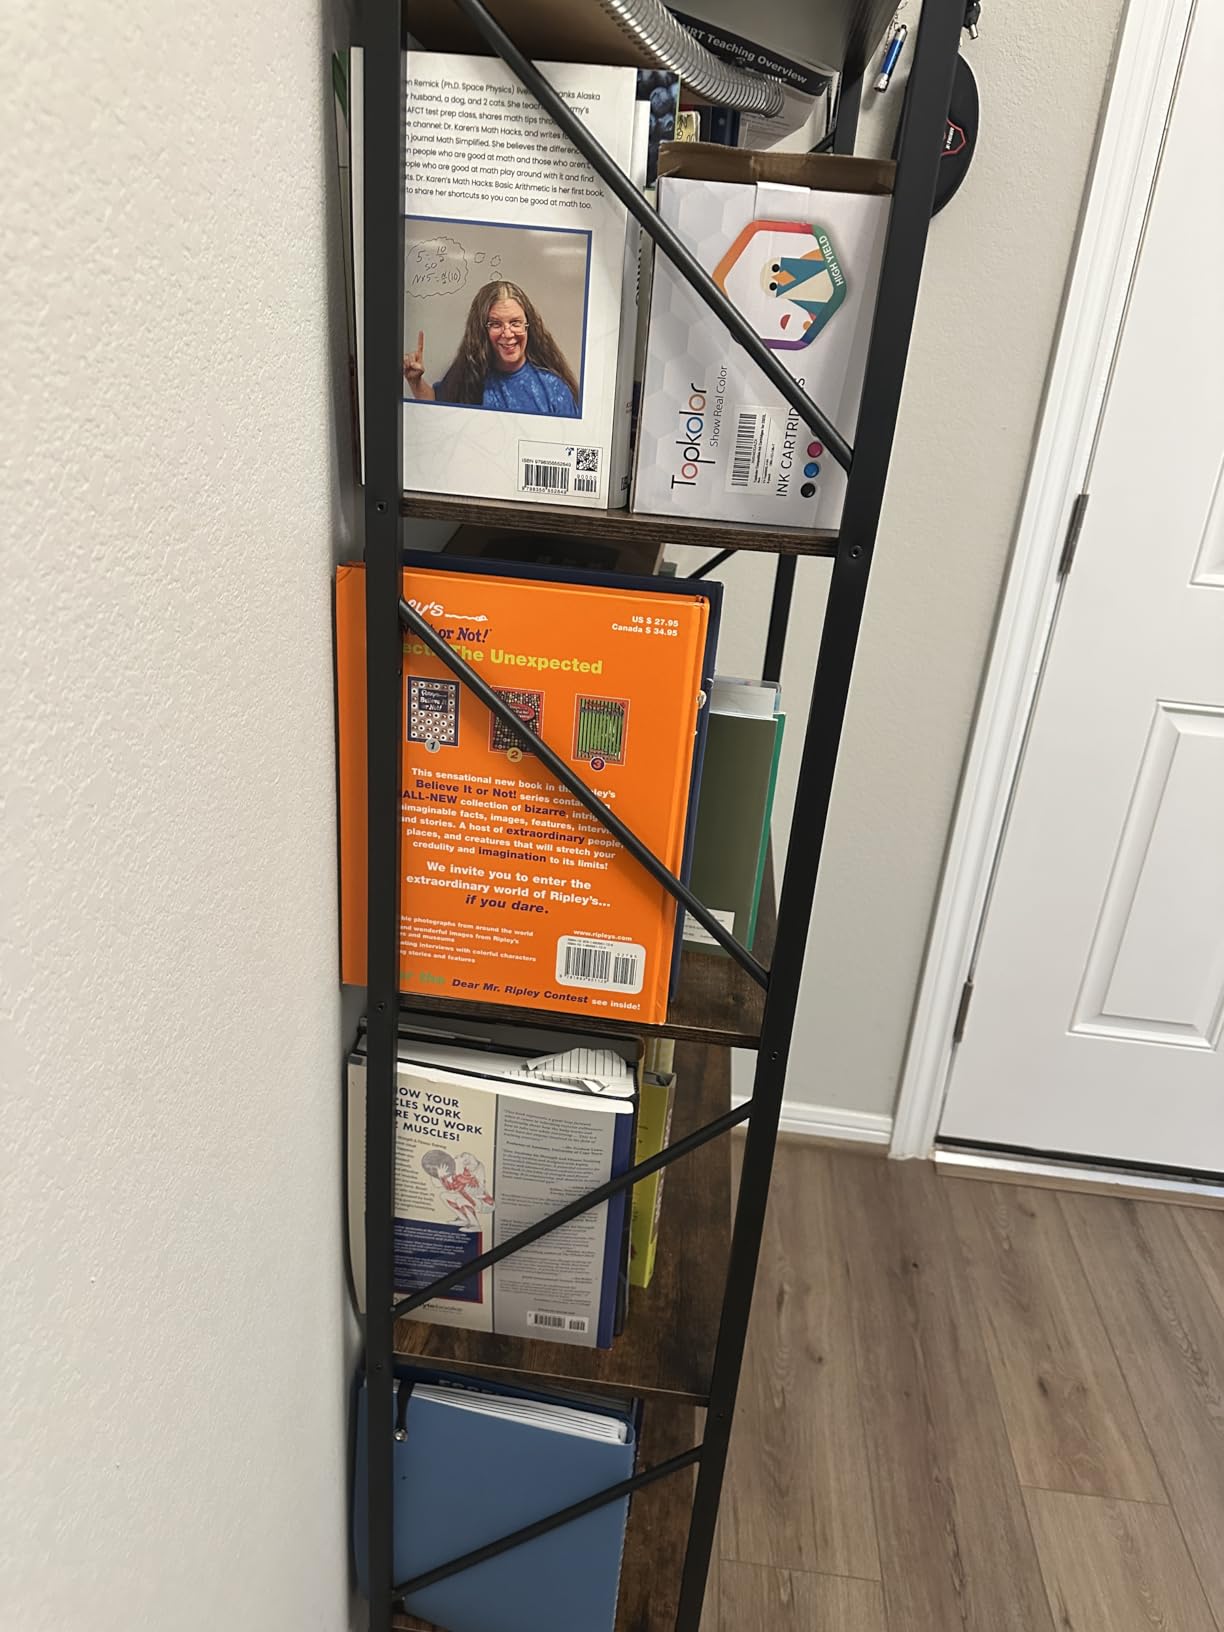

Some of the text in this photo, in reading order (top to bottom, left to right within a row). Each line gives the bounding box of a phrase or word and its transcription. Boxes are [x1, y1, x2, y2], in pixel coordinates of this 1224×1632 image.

[707, 33, 808, 84] Teaching Overview
[410, 92, 442, 104] husband,
[413, 78, 439, 87] Remick
[461, 82, 484, 92] Space
[485, 84, 514, 95] Physics)
[576, 91, 600, 100] Alaska
[425, 107, 438, 115] test
[440, 110, 456, 119] prep
[478, 112, 502, 120] shares
[524, 115, 537, 125] tips
[453, 123, 479, 132] Karen's
[480, 125, 498, 134] Math
[540, 130, 560, 138] writes
[410, 133, 434, 143] journal
[436, 135, 453, 144] Math
[491, 139, 504, 147] She
[506, 140, 534, 150] believes
[536, 143, 548, 151] the
[412, 148, 436, 157] people
[466, 152, 485, 160] good
[531, 156, 551, 164] those
[450, 164, 469, 173] good
[500, 168, 514, 178] play
[580, 174, 594, 182] find
[426, 175, 450, 184] Karen's
[452, 177, 470, 185] Math
[494, 180, 513, 189] Basic
[514, 182, 550, 192] Arithmetic
[570, 187, 584, 195] first
[414, 186, 433, 195] share
[447, 189, 479, 199] shortcuts
[490, 194, 503, 202] you
[530, 198, 548, 206] good
[818, 236, 844, 286] HIGH YIELD
[709, 366, 727, 447] Show Real Color
[671, 383, 716, 489] Topkolor
[776, 474, 790, 496] INK
[611, 624, 678, 637] Canada $ 34.95
[632, 616, 678, 628] US $ 27.95
[456, 626, 488, 643] Not!
[490, 648, 602, 674] Unexpected
[410, 766, 554, 792] This sensational new book in
[415, 778, 549, 804] Believe It or Not! series
[402, 788, 568, 819] ALL-NEW collection of bizarre,
[419, 816, 584, 846] stories. A host of extraordinary
[459, 809, 574, 833] facts, images, features,
[406, 826, 615, 860] places, and creatures that will stretch your
[412, 840, 608, 871] credulity and imagination to its limits!
[426, 860, 591, 890] We invite you to enter the
[406, 873, 610, 908] extraordinary world of Ripley's...
[464, 893, 548, 914] if you dare.
[412, 926, 448, 935] wonderful
[448, 929, 473, 938] images
[492, 934, 519, 944] Ripley's
[573, 930, 632, 944] www.ripleys.com
[452, 978, 641, 1011] Dear Mr. Ripley Contest see inside!
[426, 1092, 458, 1108] YOUR
[423, 1104, 460, 1119] WORK
[402, 1122, 460, 1142] MUSCLES!
[414, 1113, 438, 1126] YOU
[444, 1120, 482, 1134] WORK
